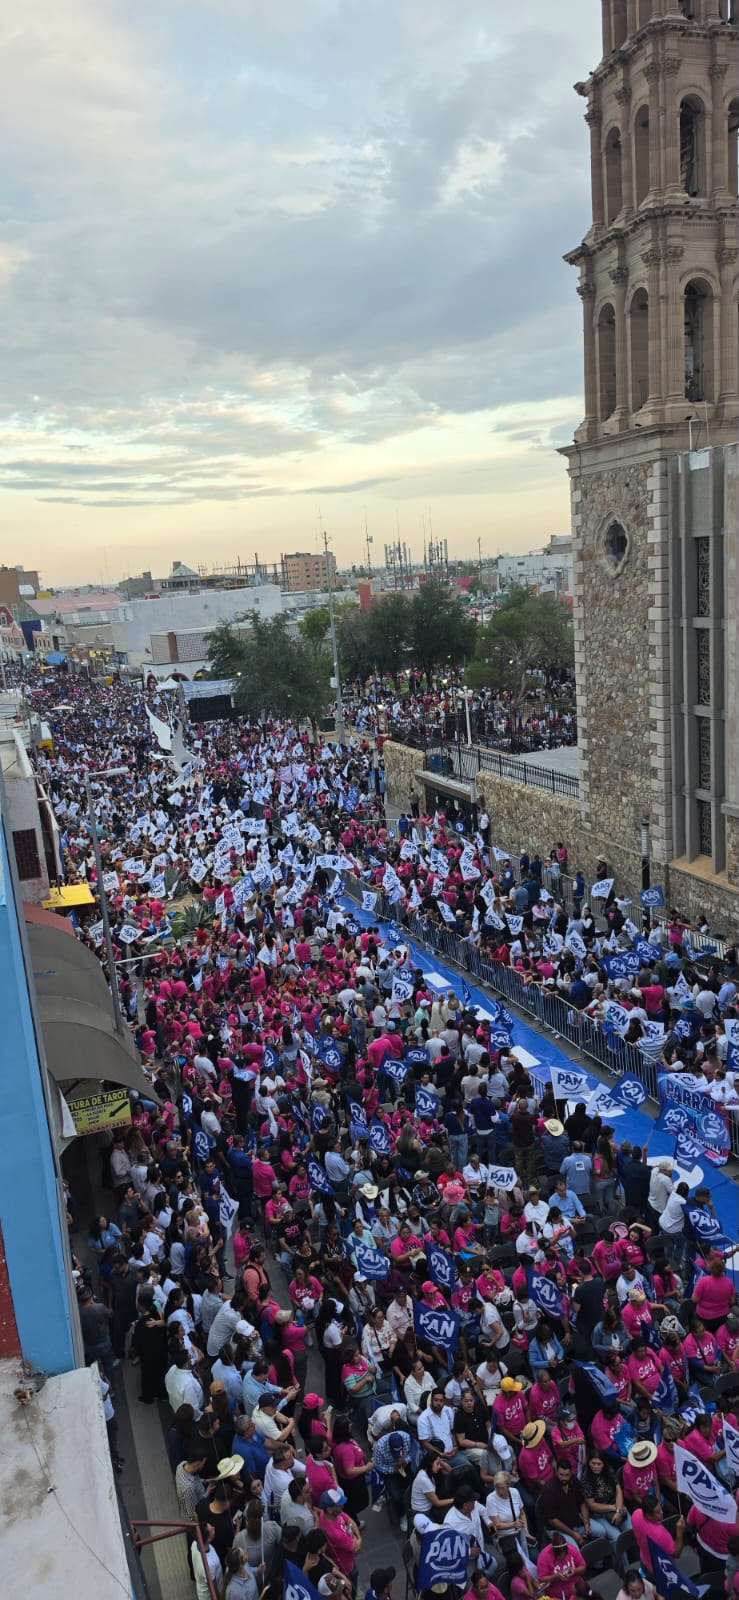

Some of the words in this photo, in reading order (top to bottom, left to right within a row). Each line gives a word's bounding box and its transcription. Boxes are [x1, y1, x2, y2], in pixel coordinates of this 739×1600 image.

[383, 1060, 408, 1077] PAN
[557, 1073, 583, 1085] PAN
[91, 1096, 102, 1106] DE
[102, 1090, 128, 1102] TAROT
[620, 1079, 646, 1105] PAN
[677, 1133, 701, 1158] PAN
[490, 1172, 514, 1185] PAN
[420, 1314, 456, 1338] PAN
[425, 1535, 467, 1563] PAN
